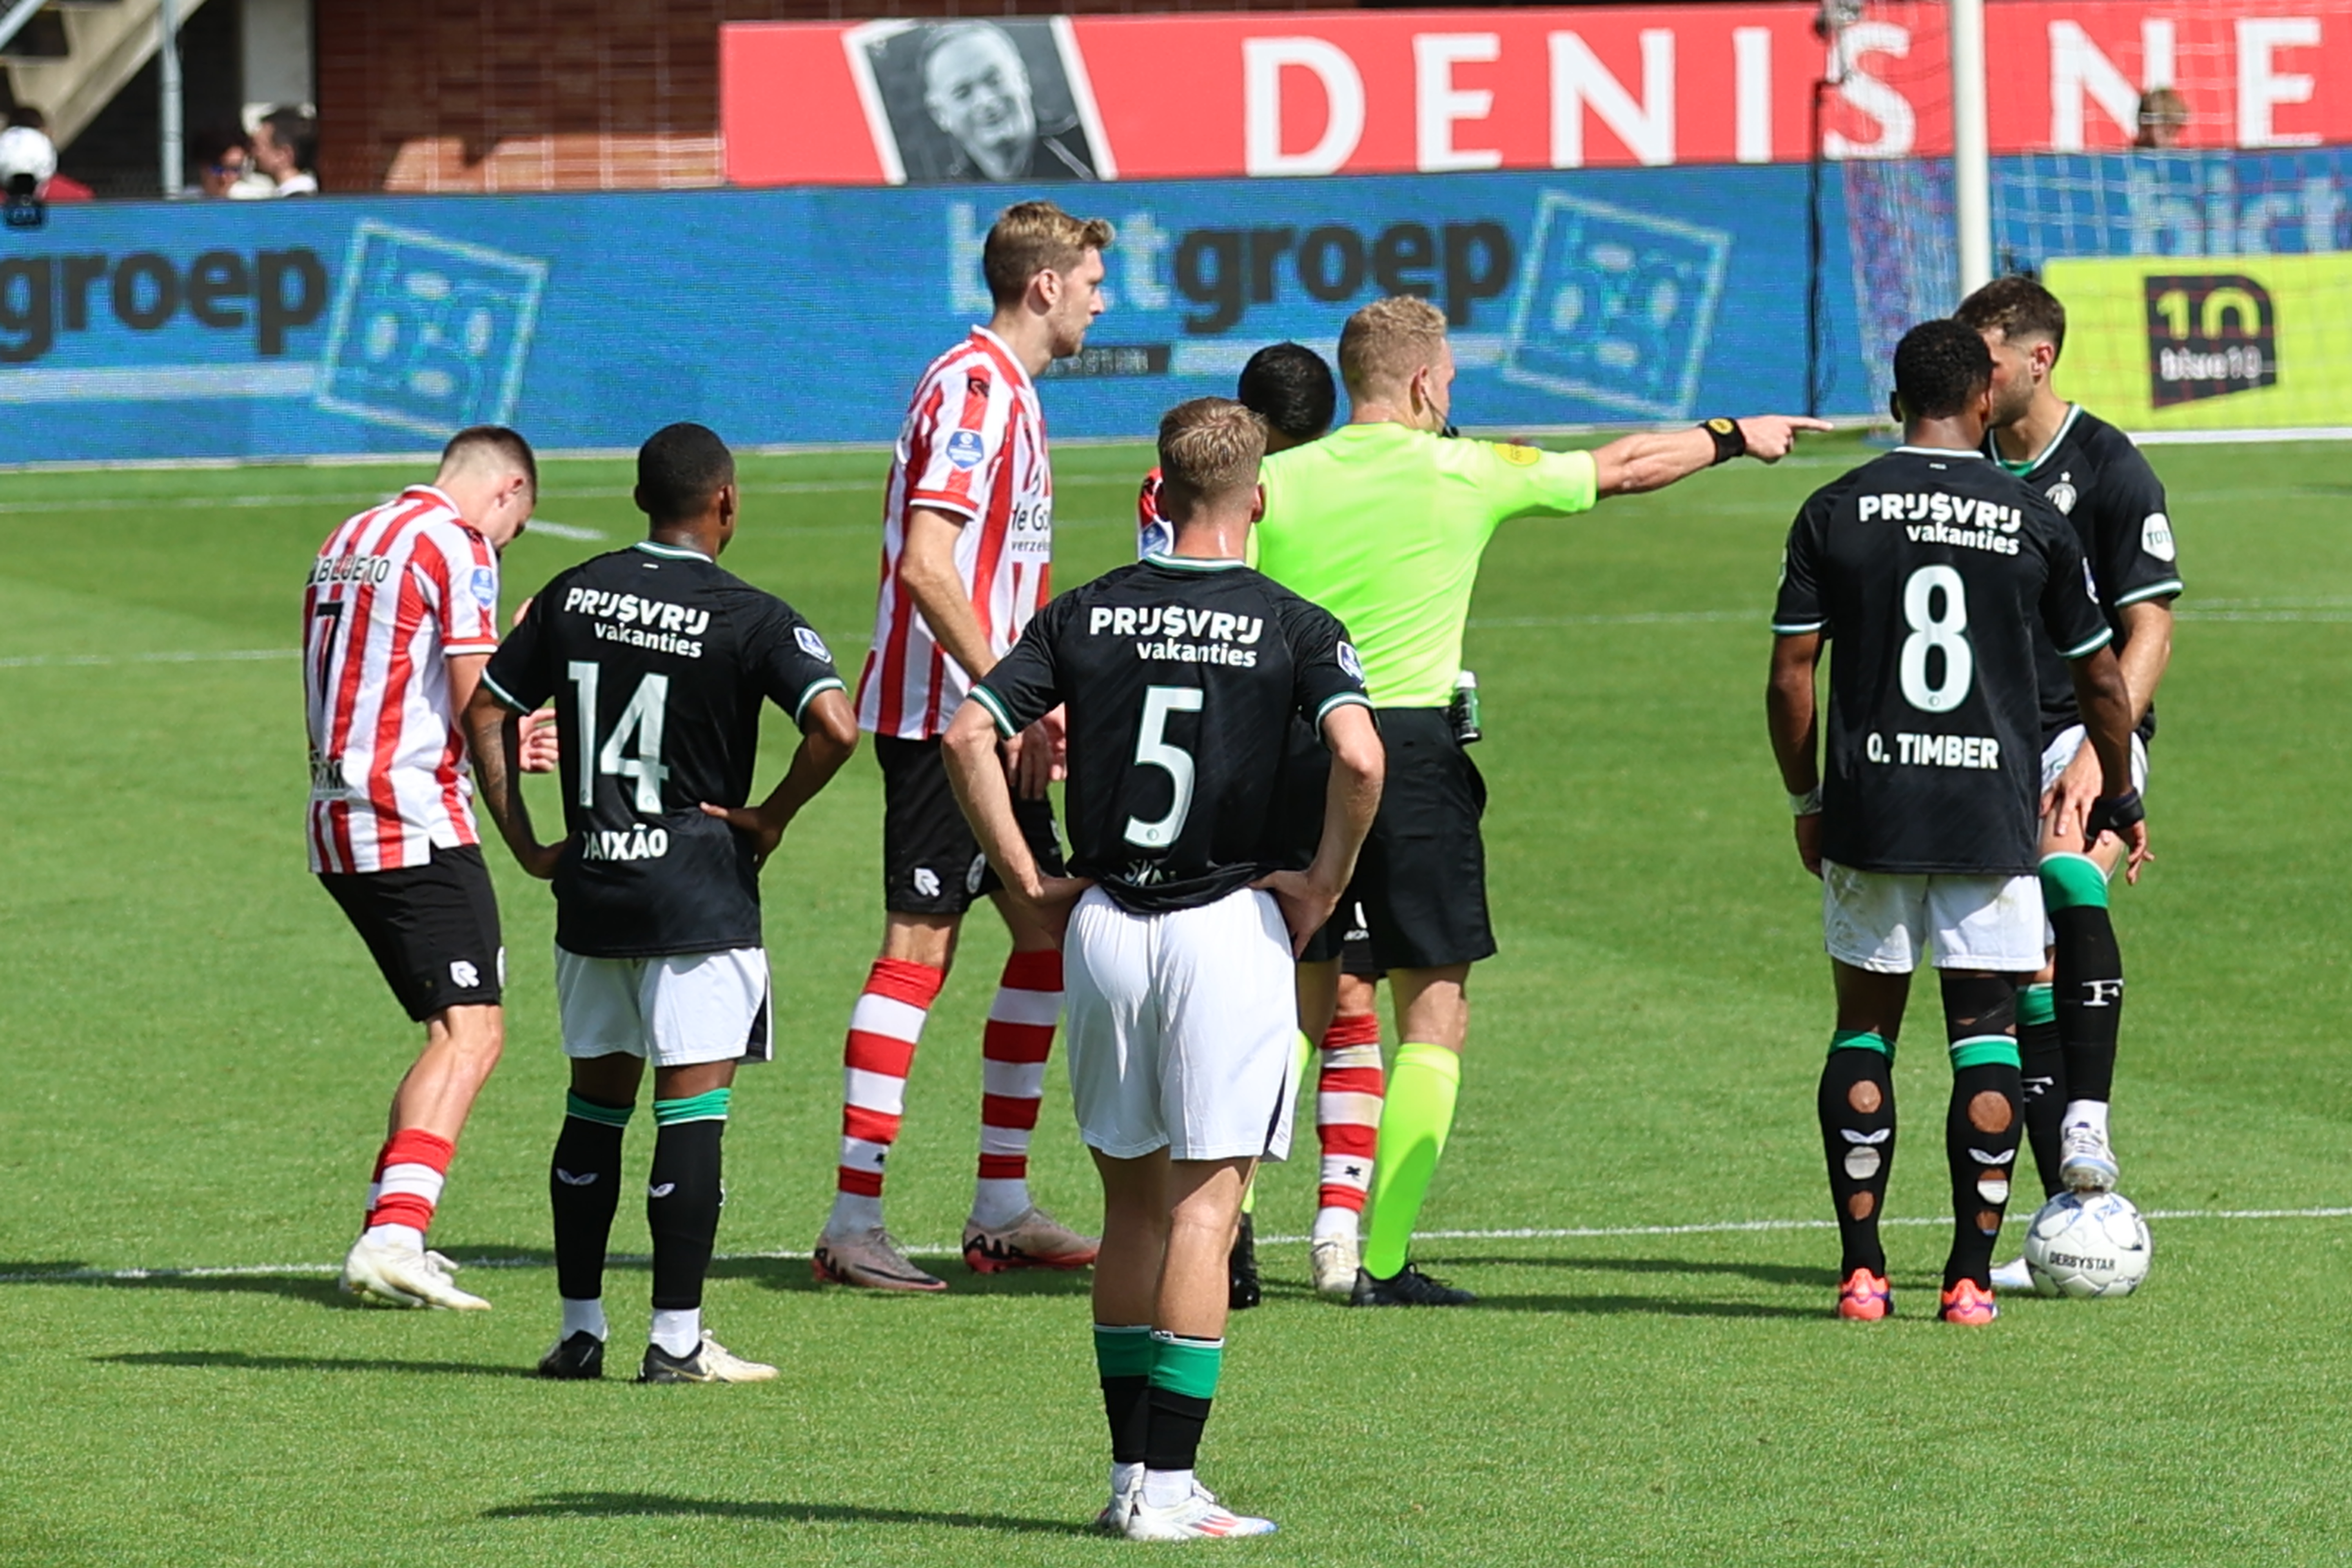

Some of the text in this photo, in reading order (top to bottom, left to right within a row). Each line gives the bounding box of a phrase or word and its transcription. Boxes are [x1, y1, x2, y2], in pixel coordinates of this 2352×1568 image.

[1242, 20, 1917, 176] DENIS
[0, 248, 327, 363] groep
[1906, 523, 2020, 555] vakanties
[315, 601, 344, 710] 7
[594, 622, 704, 659] vakanties
[1136, 638, 1258, 668] vakanties
[1900, 564, 1973, 713] 8
[568, 660, 670, 815] 14
[1123, 684, 1204, 848] 5
[1896, 734, 1998, 769] TIMBER
[2049, 1250, 2116, 1270] DERBYSTAR
